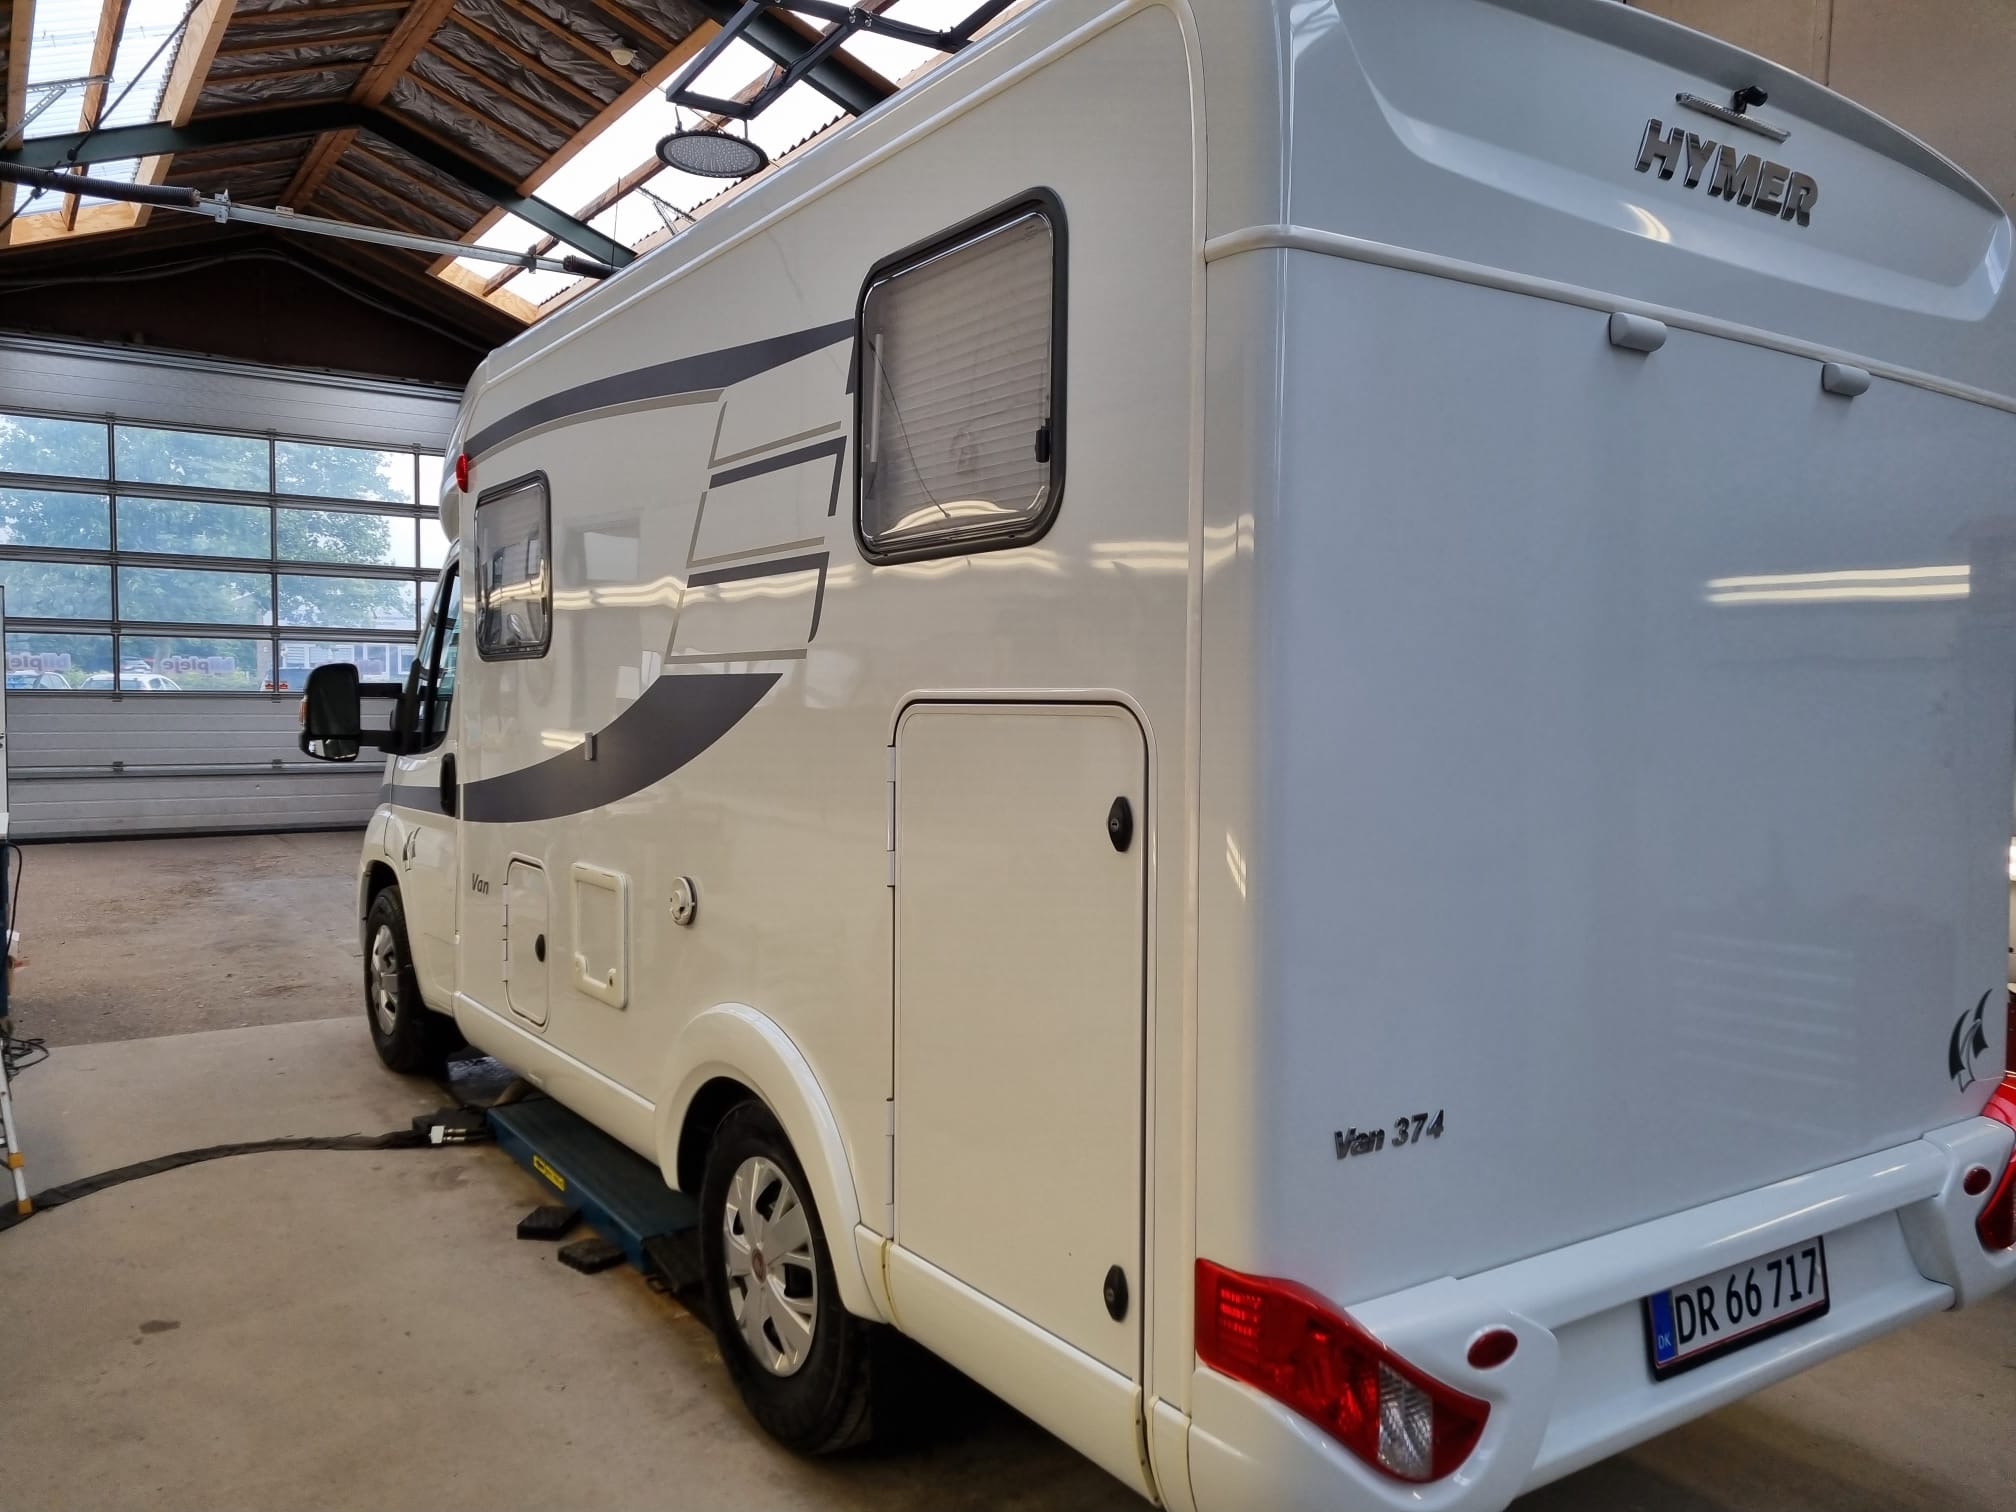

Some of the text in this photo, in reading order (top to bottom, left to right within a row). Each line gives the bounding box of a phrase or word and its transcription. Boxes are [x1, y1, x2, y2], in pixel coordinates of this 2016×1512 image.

[1633, 118, 1819, 227] HYMER
[471, 872, 490, 895] Van
[1334, 1109, 1445, 1160] Van 374
[1674, 1247, 1816, 1345] DR 66 717
[1657, 1331, 1672, 1350] DK
